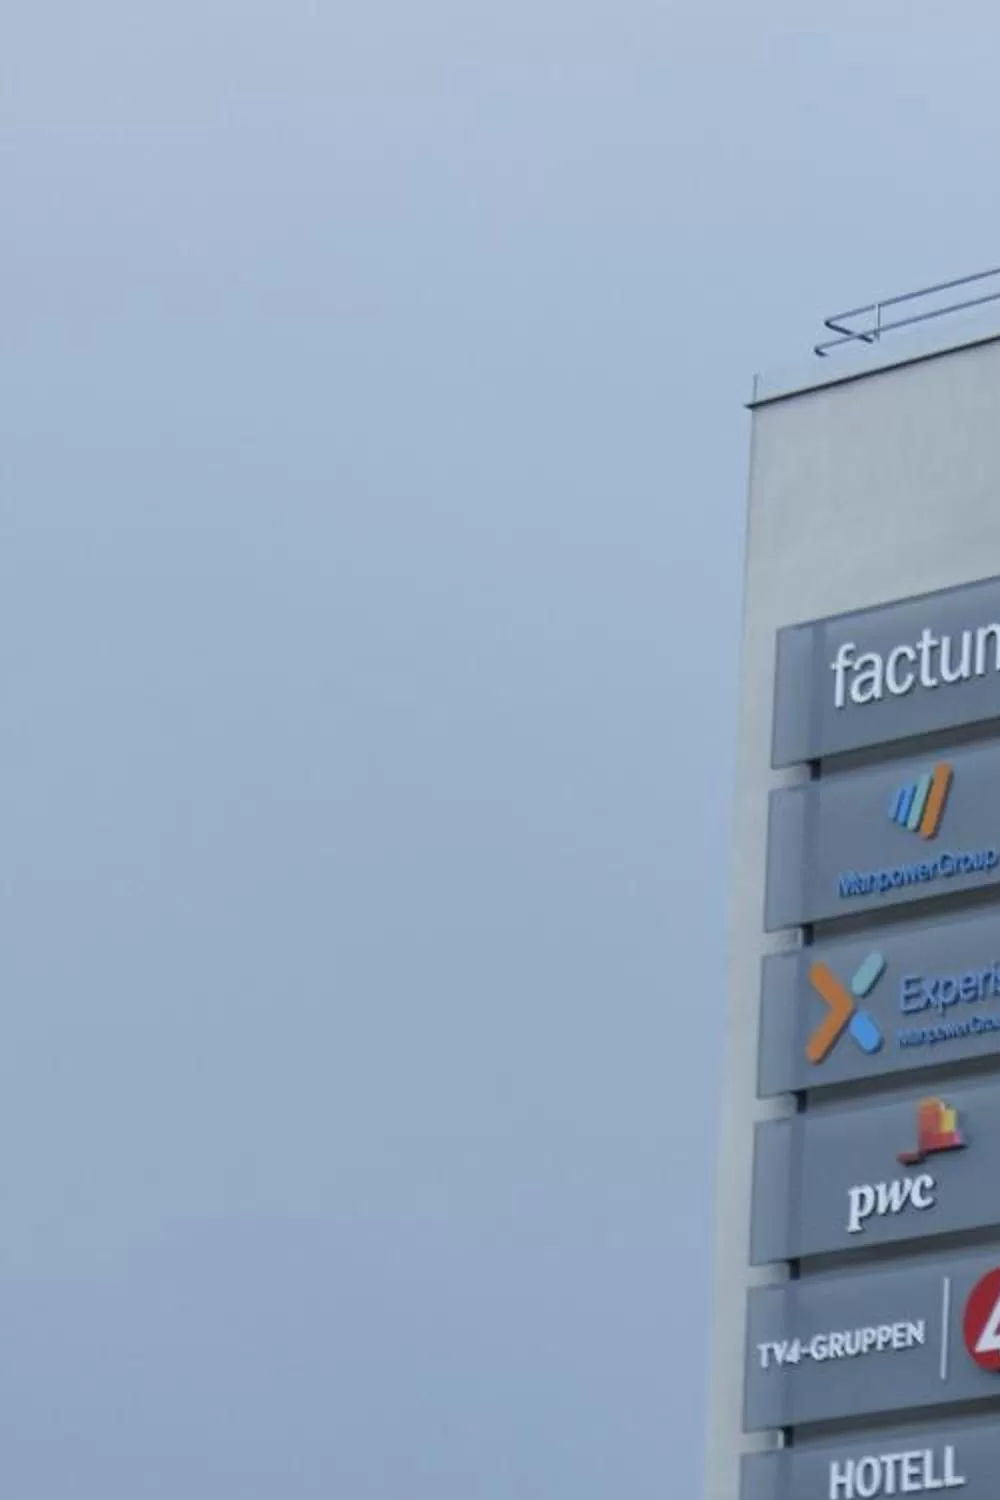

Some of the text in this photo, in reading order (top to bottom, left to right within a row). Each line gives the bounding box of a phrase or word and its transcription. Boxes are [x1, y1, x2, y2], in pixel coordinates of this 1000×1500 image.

[835, 848, 1000, 899] ManpowerGroup
[846, 1173, 936, 1234] pwc
[757, 1319, 926, 1369] TV4-GRUPPEN
